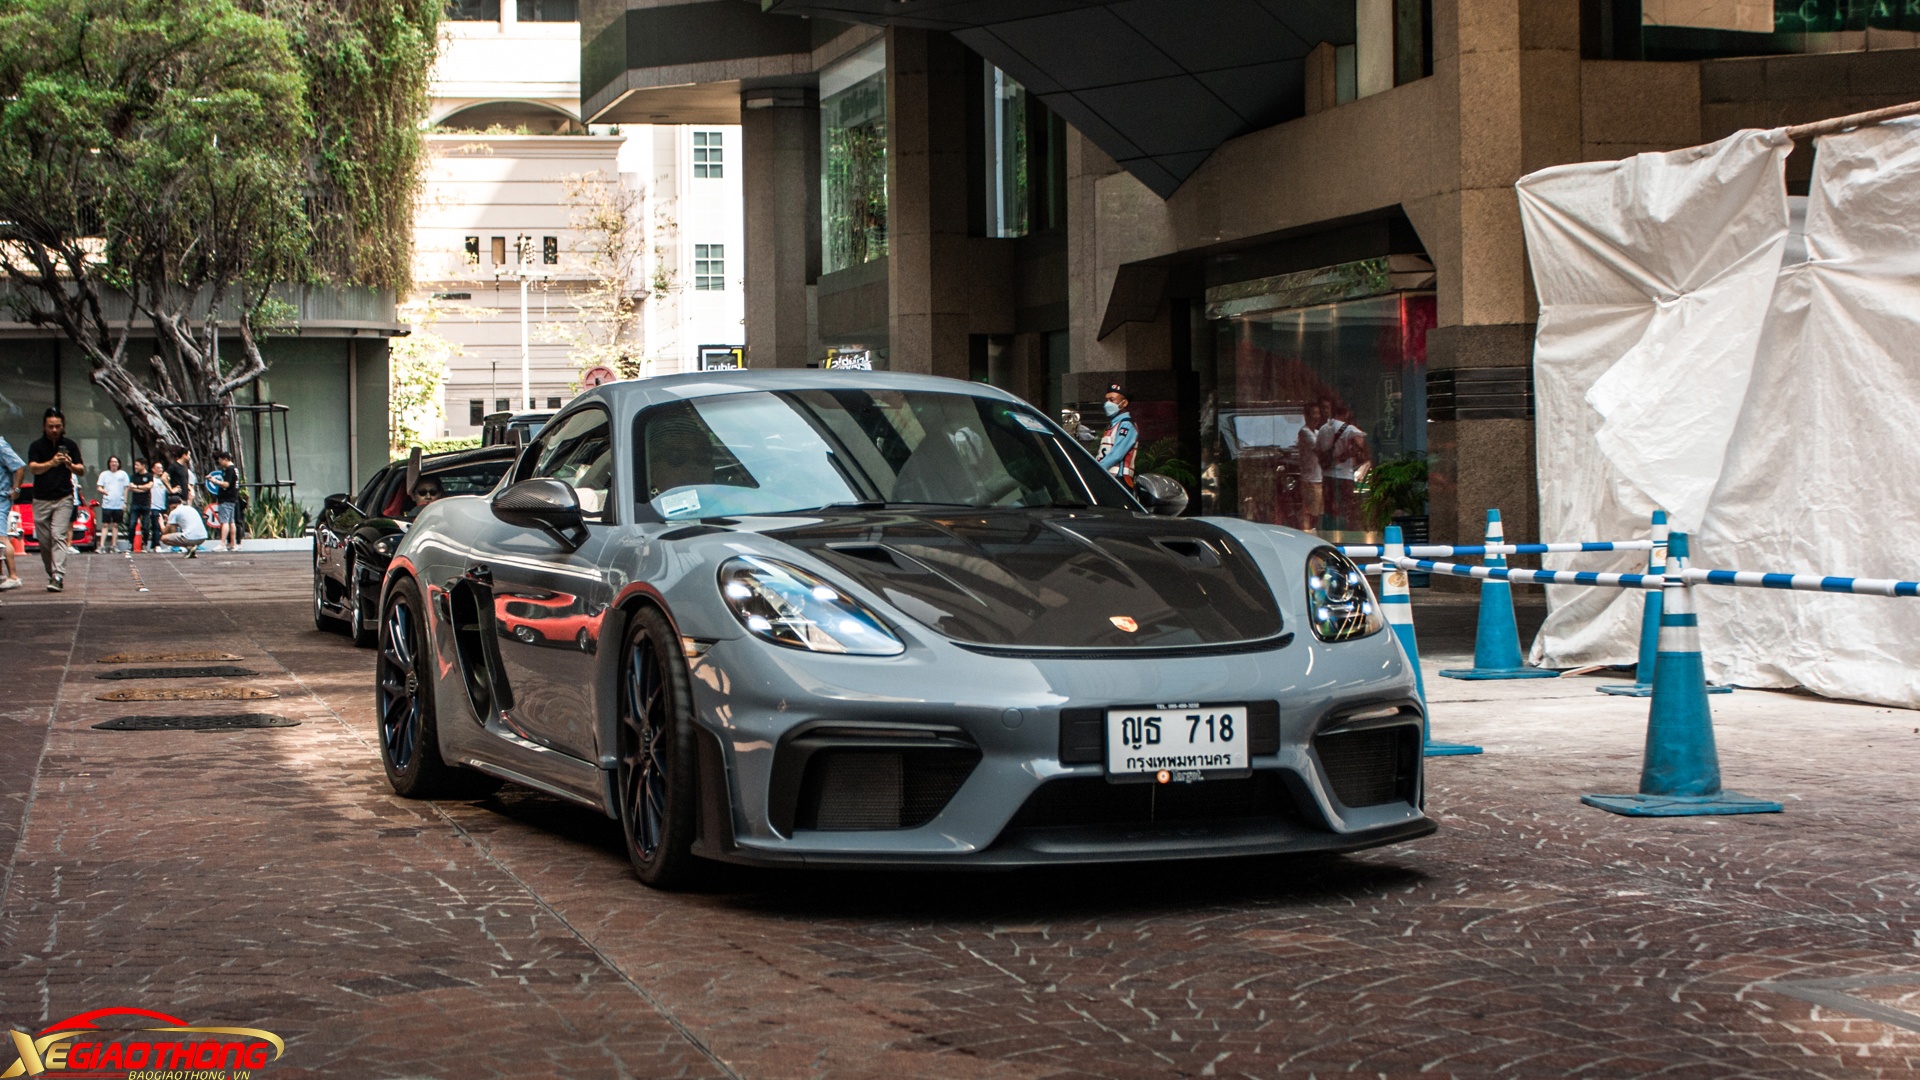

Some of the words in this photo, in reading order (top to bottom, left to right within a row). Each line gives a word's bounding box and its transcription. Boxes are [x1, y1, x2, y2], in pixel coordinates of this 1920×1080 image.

[1121, 716, 1162, 750] ญธ
[1185, 714, 1234, 743] 718
[1126, 754, 1231, 772] กรุงเทพมหานคร
